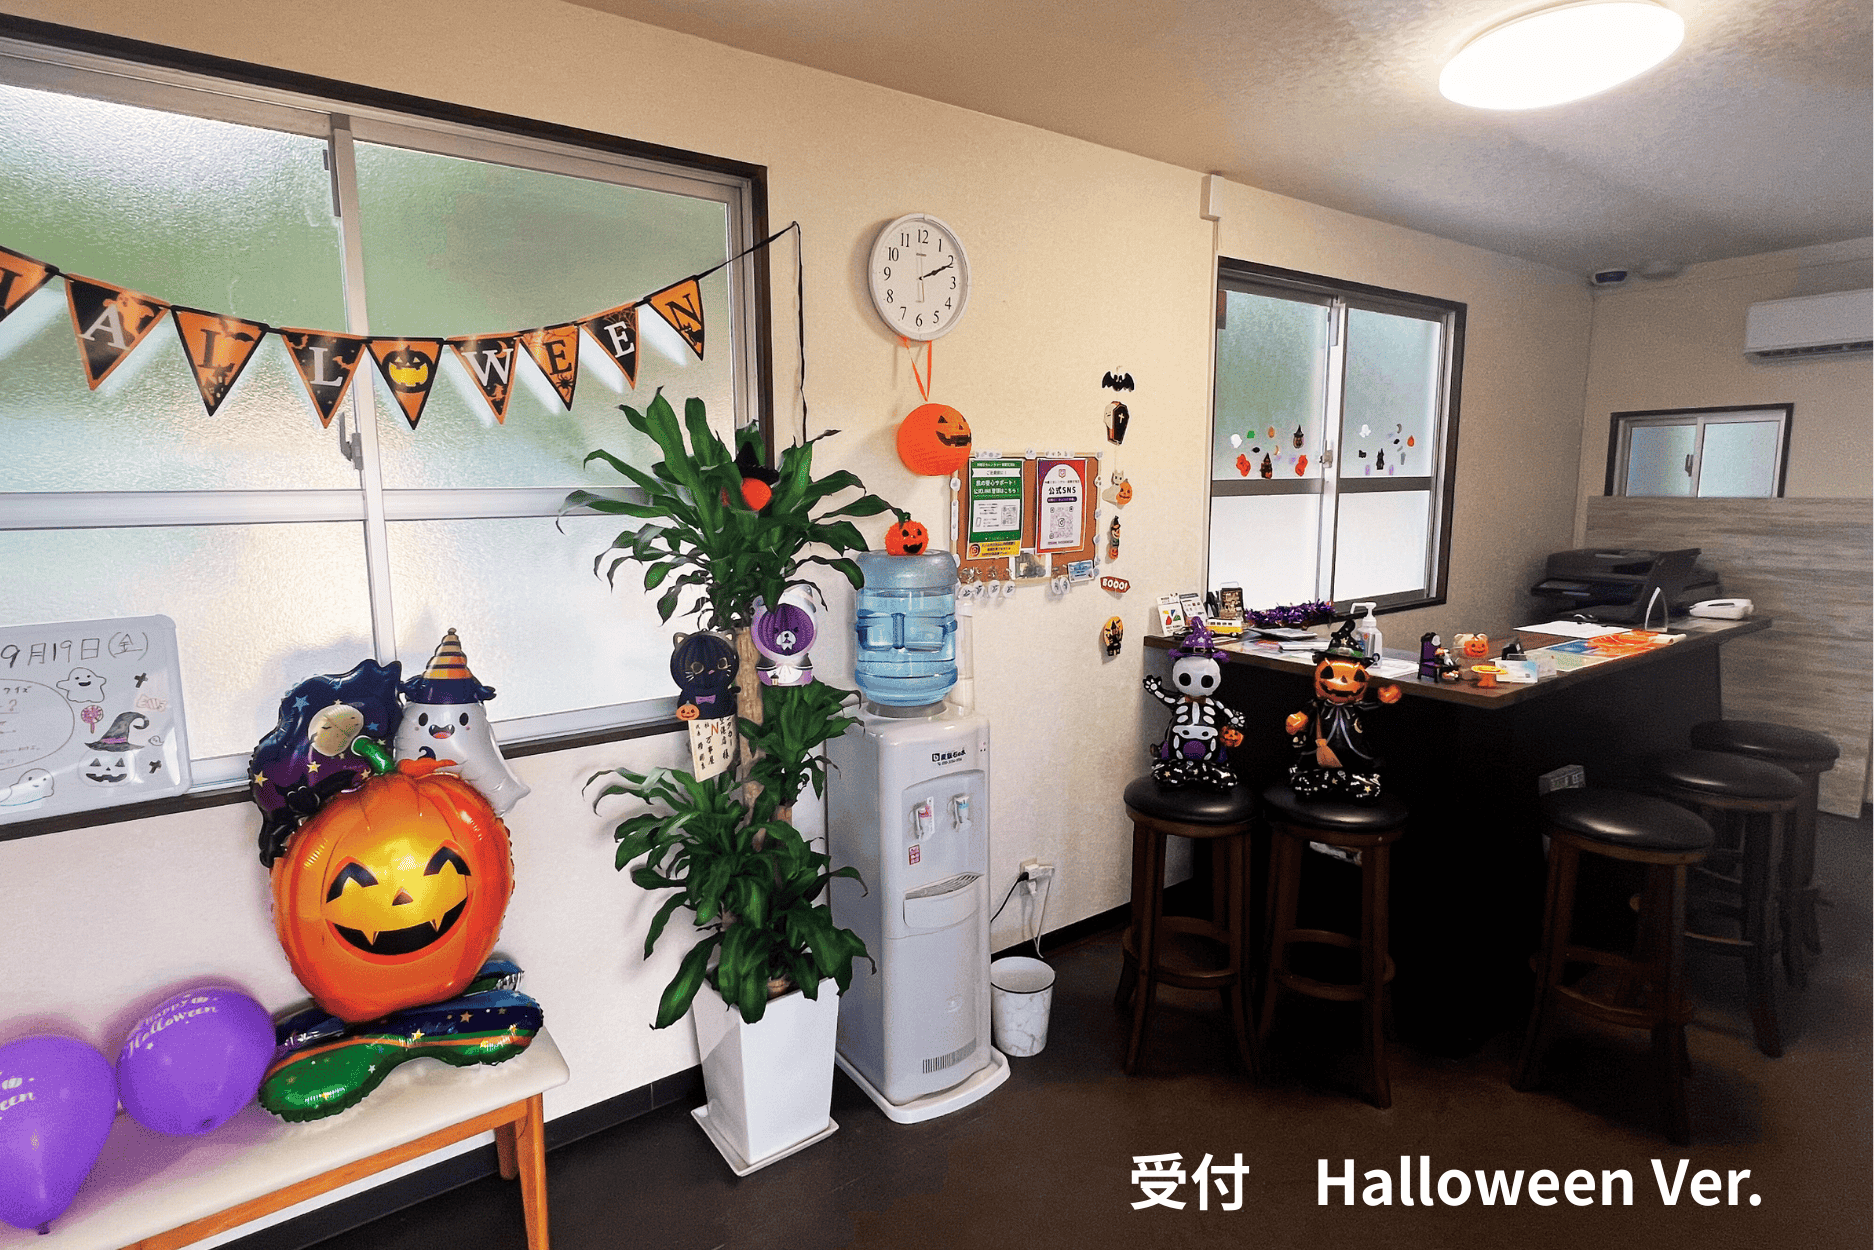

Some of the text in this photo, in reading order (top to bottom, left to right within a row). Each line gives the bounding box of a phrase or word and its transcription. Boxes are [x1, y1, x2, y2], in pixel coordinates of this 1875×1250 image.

[901, 232, 910, 248] 11
[917, 229, 929, 244] 12
[938, 238, 942, 252] 1
[888, 246, 900, 262] 10
[947, 255, 954, 268] 2
[883, 266, 891, 281] 9
[949, 276, 956, 290] 3
[886, 288, 894, 303] 8
[944, 296, 952, 310] 4
[900, 306, 907, 320] 7
[915, 313, 923, 327] 6
[932, 310, 940, 324] 5
[1048, 486, 1077, 495] 公式SNS
[1102, 578, 1128, 591] BOOO!
